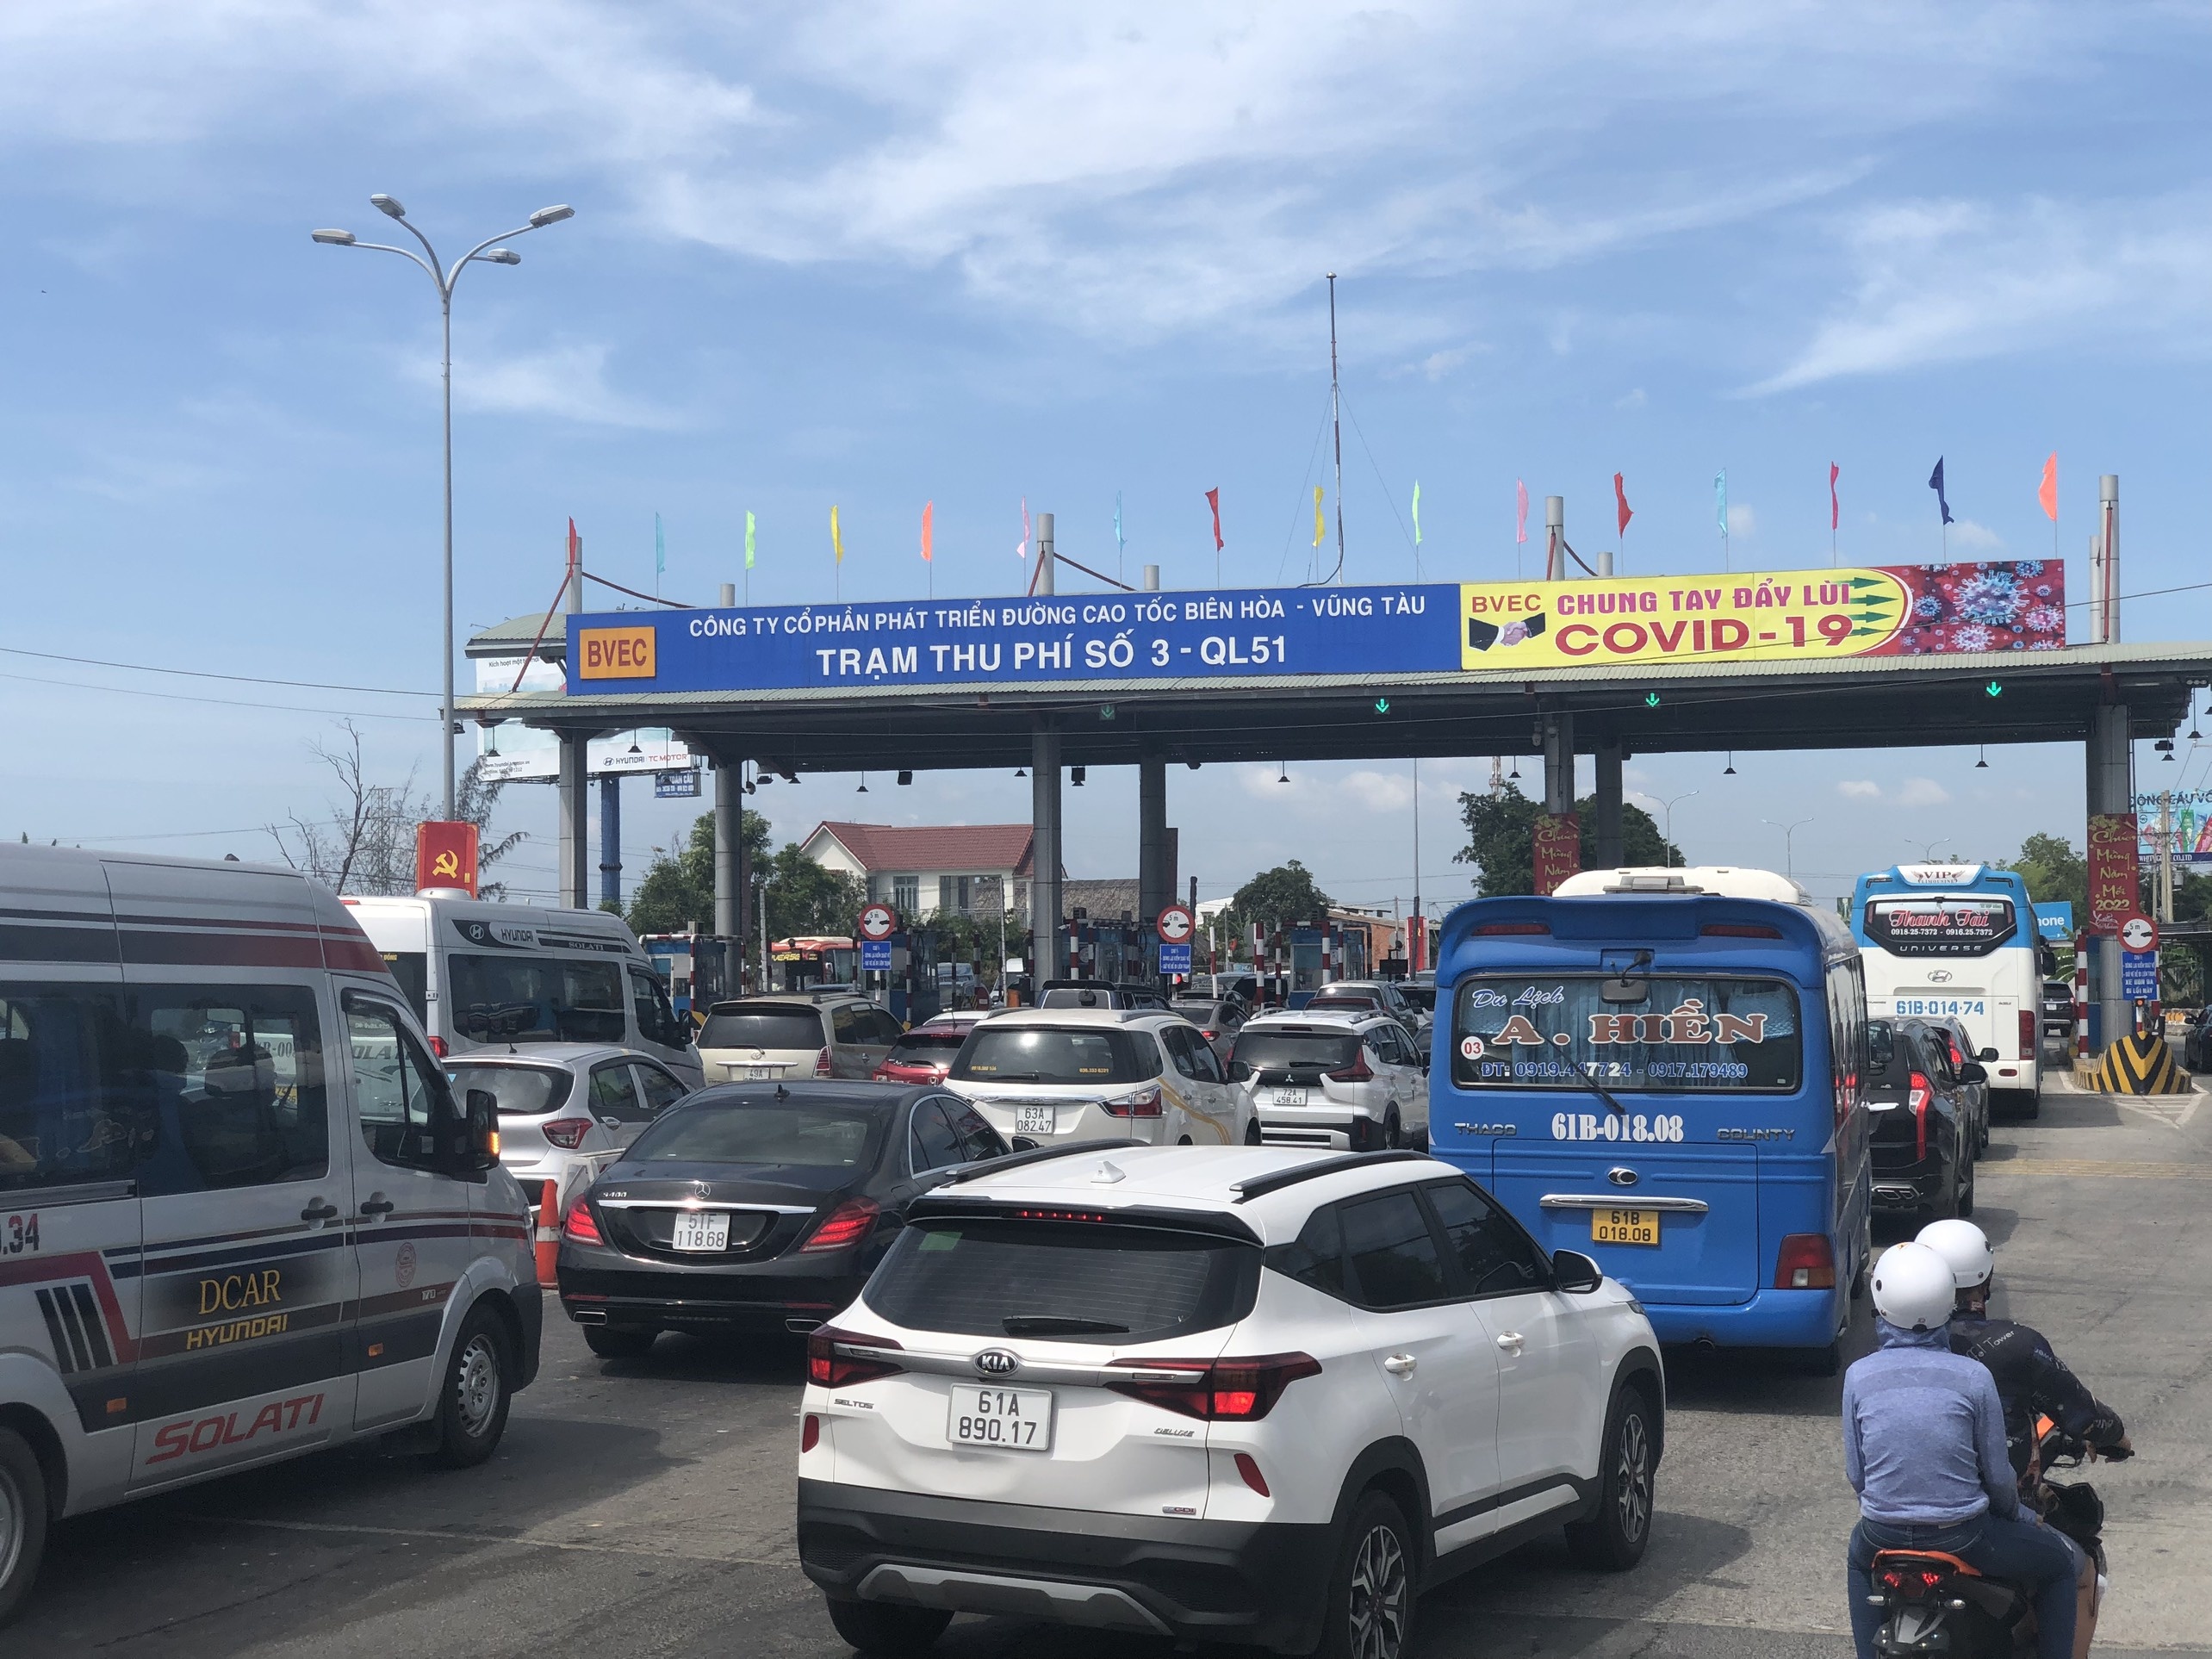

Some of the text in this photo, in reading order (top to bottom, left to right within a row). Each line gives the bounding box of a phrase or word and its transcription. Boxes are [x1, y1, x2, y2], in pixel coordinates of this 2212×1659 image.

[1472, 594, 1542, 613] BVEC
[1556, 578, 1850, 617] CHUNG TAY ĐẨY LÙI
[690, 614, 747, 637] CÔNG
[753, 617, 779, 634] TY
[784, 606, 812, 634] CỔ
[815, 608, 869, 632] PHẦN
[875, 606, 929, 631] PHÁT
[935, 600, 996, 629] TRIỂN
[1002, 600, 1076, 626] ĐƯỜNG
[1082, 604, 1127, 624] CAO
[1134, 595, 1177, 622] TỐC
[1184, 596, 1232, 620] BIÊN
[1240, 594, 1285, 619] HÒA
[1312, 593, 1373, 618] VŨNG
[1381, 591, 1426, 615] TÀU
[1555, 614, 1855, 657] COVID-19
[587, 638, 647, 668] BVEC
[816, 646, 919, 680] TRẠM
[929, 643, 1001, 673] THU
[1014, 633, 1072, 670] PHÍ
[1084, 629, 1134, 668] SỐ
[1151, 639, 1170, 667] 3
[1200, 636, 1286, 666] QL51
[615, 756, 645, 765] HYUNDAI
[2095, 899, 2130, 910] 2022
[1889, 909, 1990, 927] Thanh Tài
[501, 929, 534, 942] HYUNDAI
[569, 941, 604, 951] SOLATI
[1472, 986, 1564, 1009] Du Lịch
[1491, 998, 1768, 1045] A. HIỀN
[1464, 1042, 1482, 1054] 03
[749, 1068, 763, 1078] 49A
[1482, 1062, 1511, 1077] ĐT:
[1647, 1061, 1749, 1078] 0917.179489
[1025, 1108, 1044, 1119] 63A
[1017, 1120, 1052, 1132] 082.47
[1455, 1122, 1518, 1136] THACO
[1551, 1112, 1684, 1142] 61B-018.08
[1717, 1127, 1796, 1141] COUNTY
[689, 1213, 717, 1229] 51F
[1611, 1211, 1640, 1225] 61B
[0, 1214, 40, 1255] .34
[678, 1231, 724, 1247] 118.68
[1599, 1226, 1651, 1242] 018.08
[198, 1269, 283, 1315] DCAR
[186, 1314, 288, 1351] HYUNDAI
[1983, 1330, 2015, 1348] Tower
[981, 1354, 1011, 1371] KIA
[834, 1398, 875, 1409] SELTOS
[979, 1390, 1020, 1417] 61A
[146, 1393, 325, 1465] SOLATI
[958, 1417, 1037, 1445] 890.17
[1153, 1427, 1196, 1438] DELUXE
